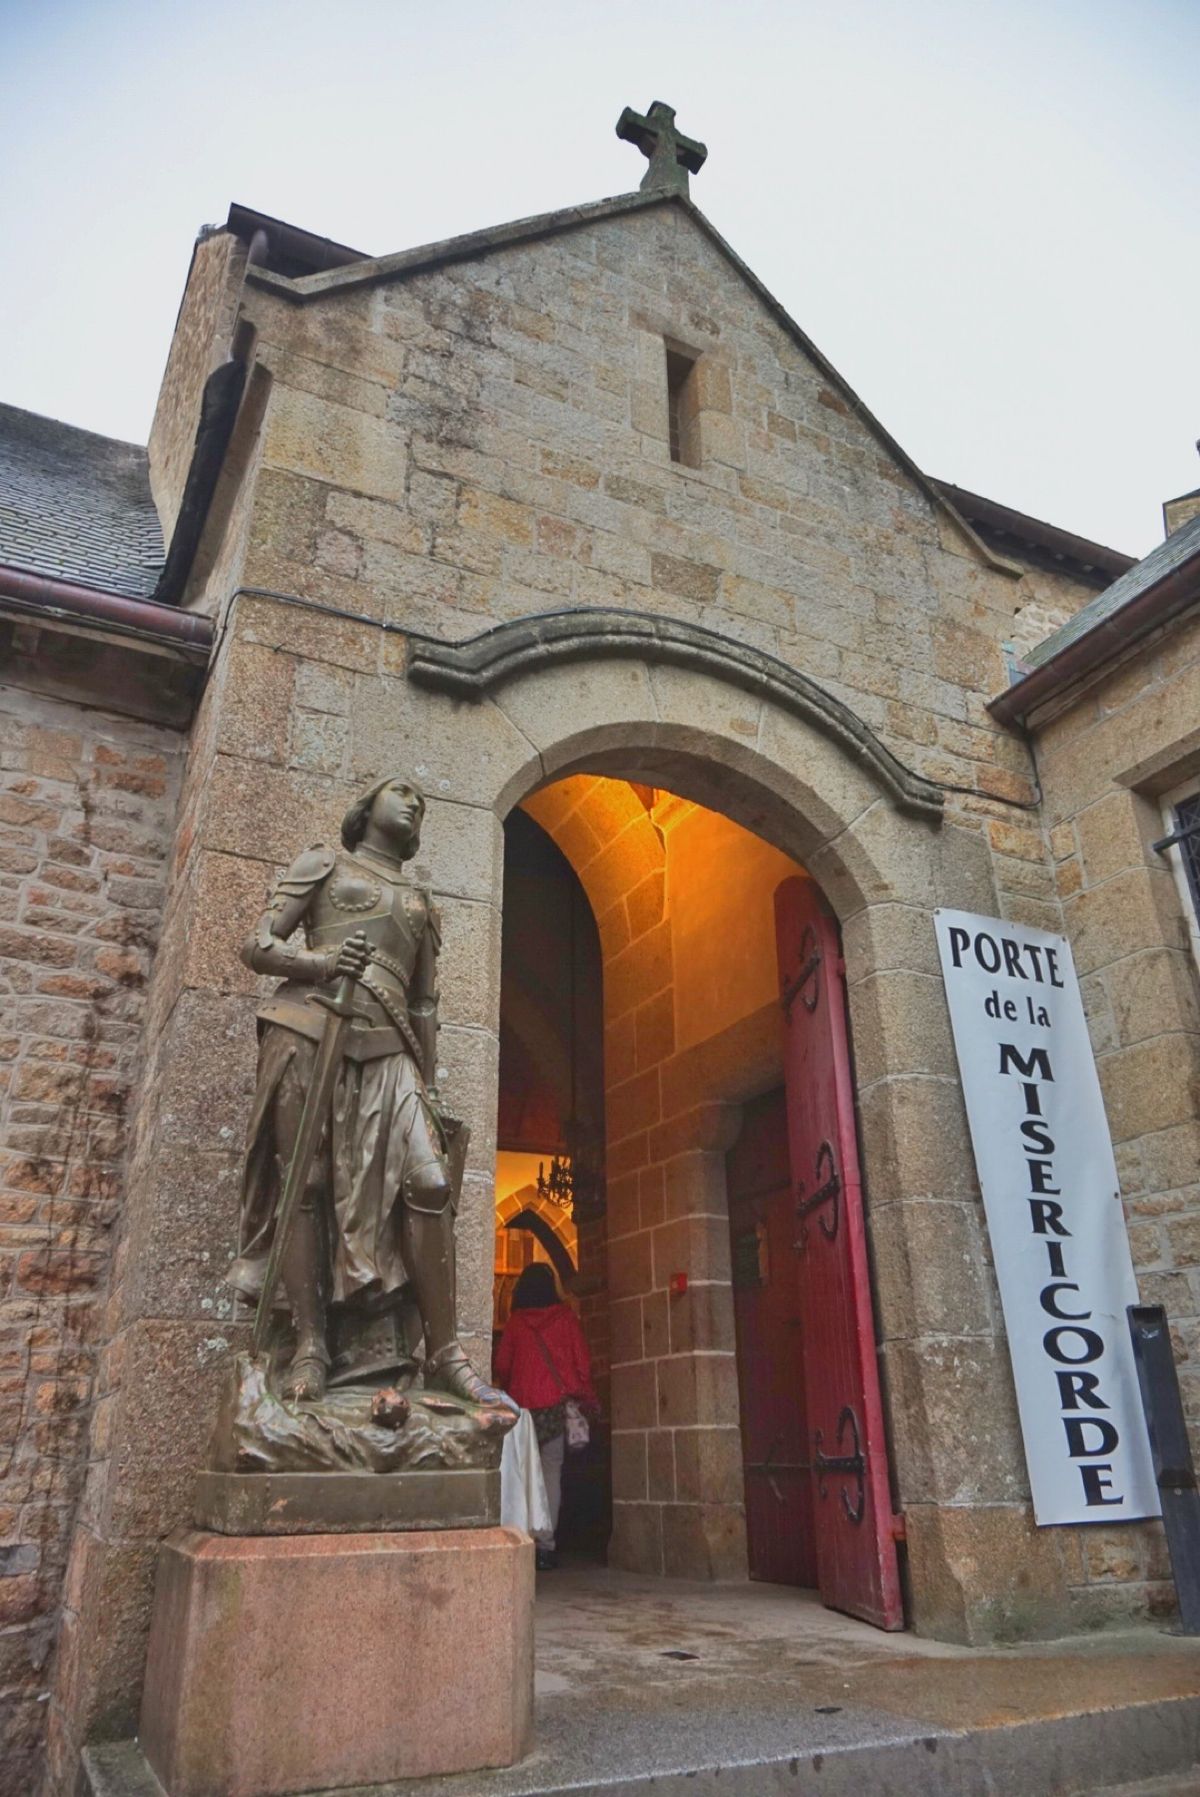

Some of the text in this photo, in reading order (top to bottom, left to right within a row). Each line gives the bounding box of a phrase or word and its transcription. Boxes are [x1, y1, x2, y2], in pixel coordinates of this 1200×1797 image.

[948, 927, 1064, 988] PORTE
[984, 990, 1051, 1028] de la
[998, 1042, 1124, 1507] MISERICORDE
